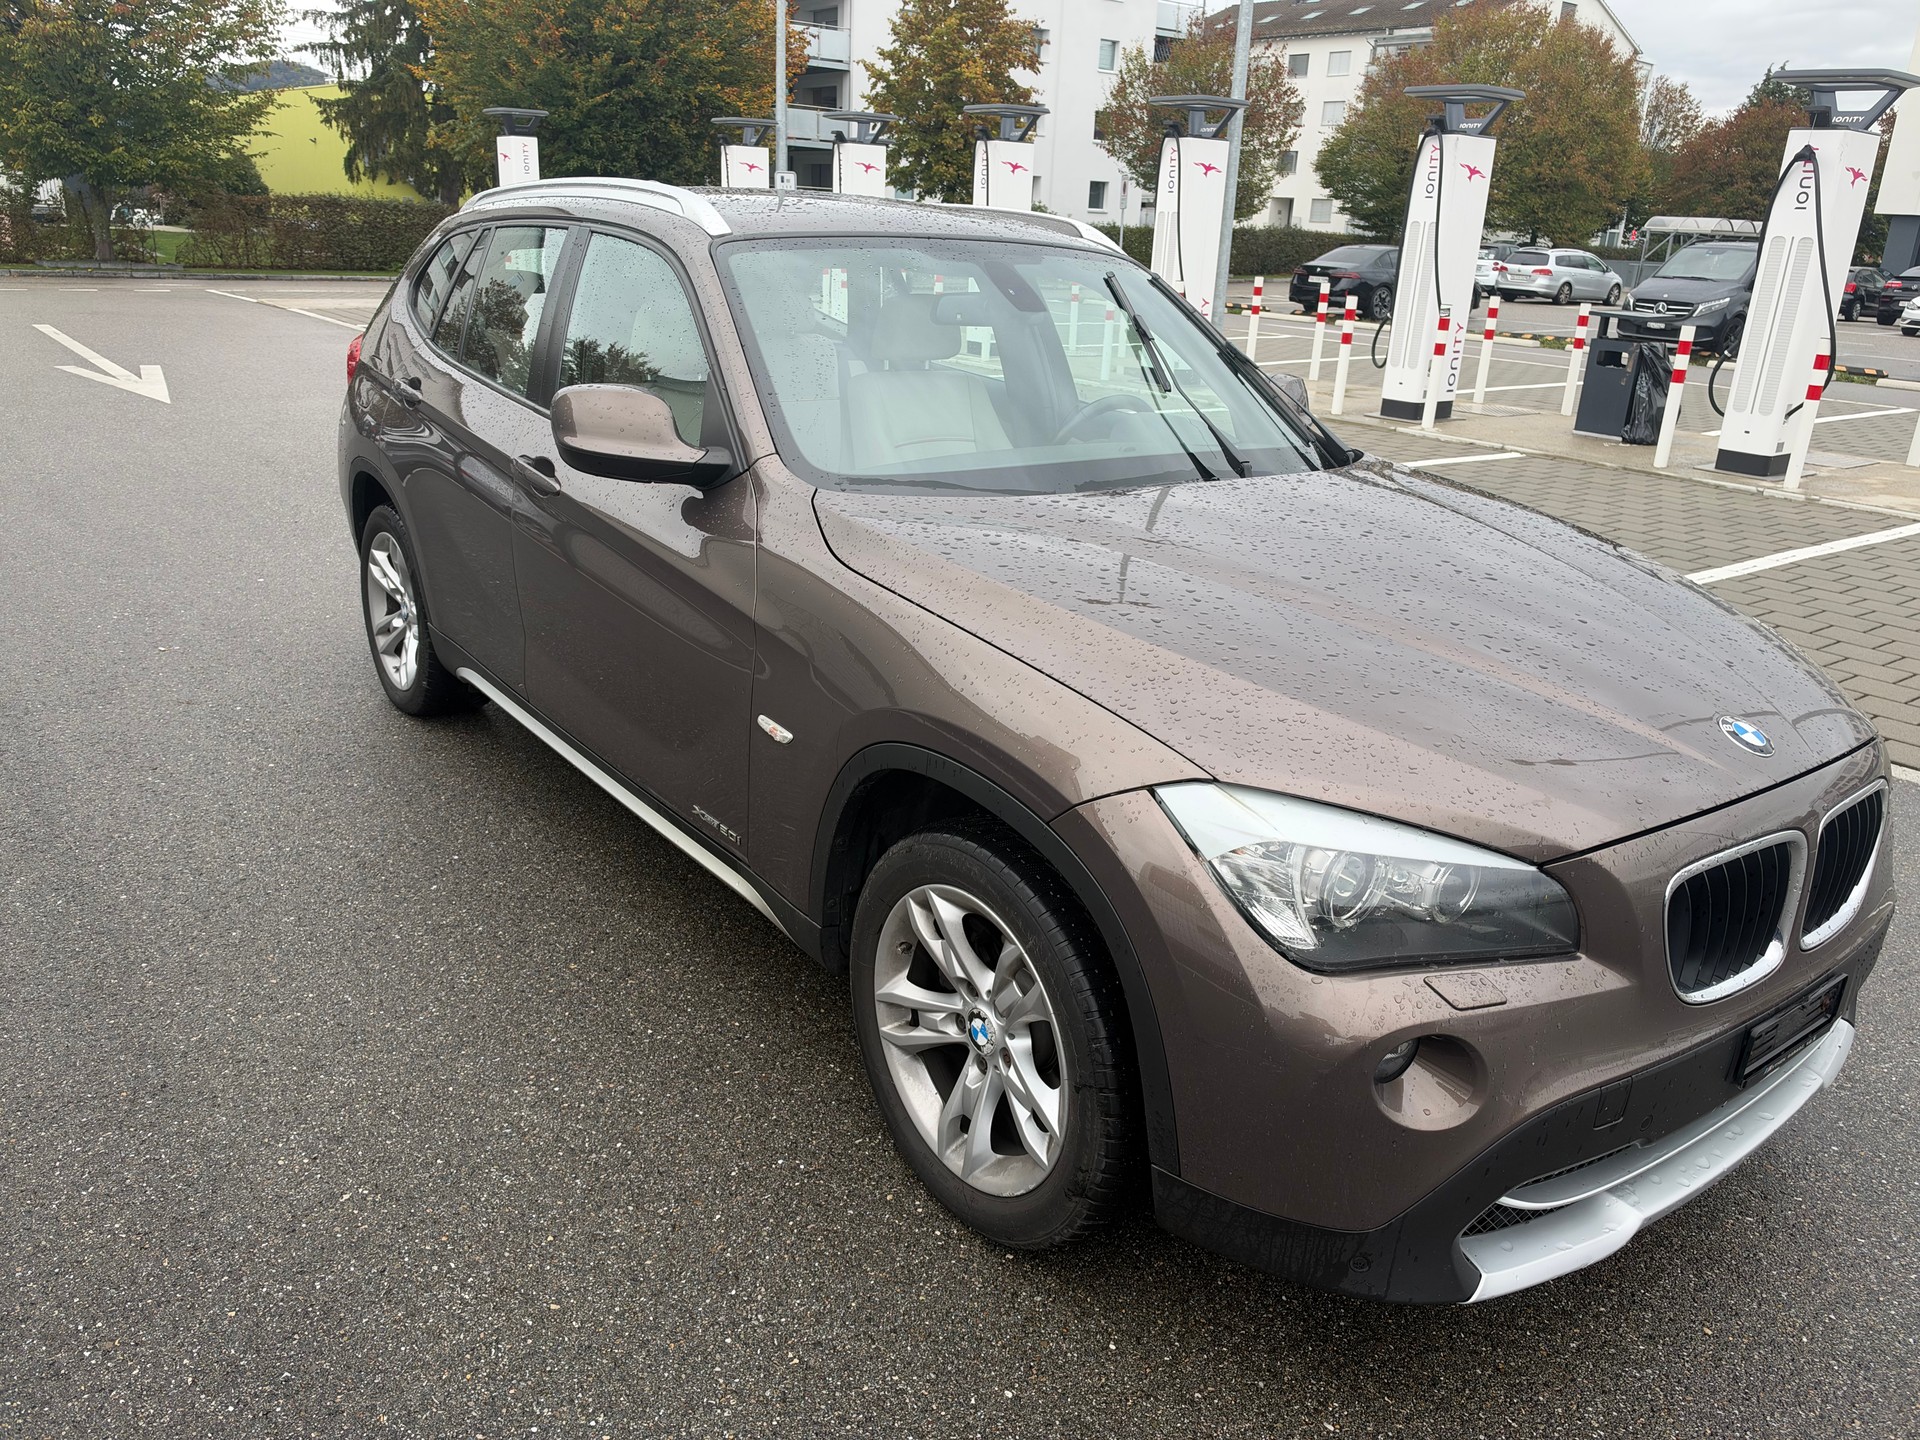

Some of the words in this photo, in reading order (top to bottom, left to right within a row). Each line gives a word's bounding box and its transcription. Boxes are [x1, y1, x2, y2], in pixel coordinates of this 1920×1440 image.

[522, 142, 531, 175] IONITY
[1168, 147, 1177, 194] IONITY
[1424, 144, 1441, 199] IONITY
[1446, 321, 1464, 393] IONITY
